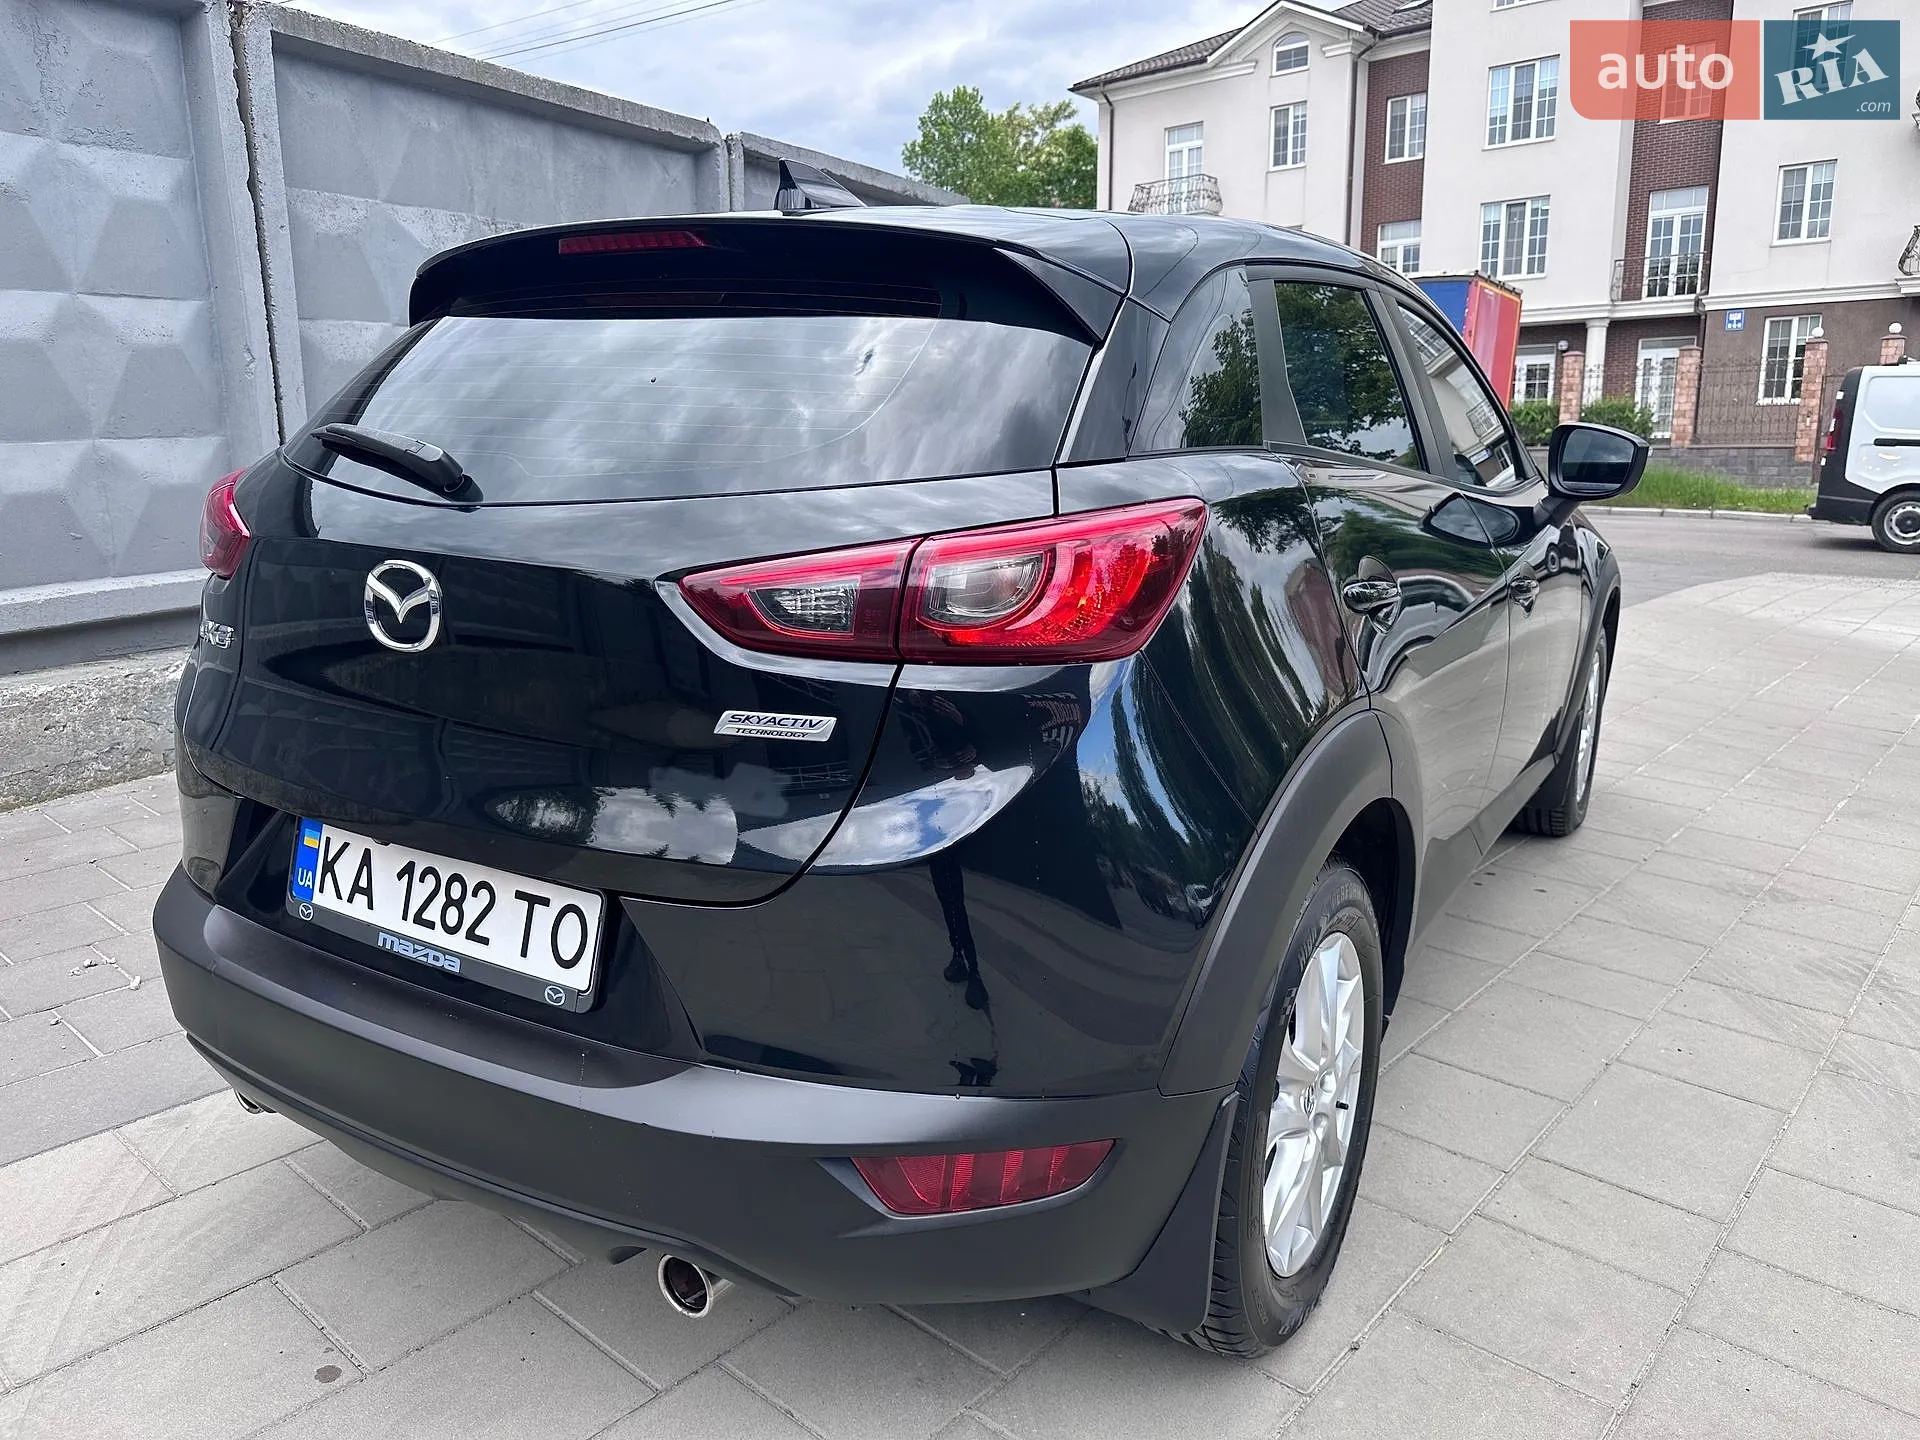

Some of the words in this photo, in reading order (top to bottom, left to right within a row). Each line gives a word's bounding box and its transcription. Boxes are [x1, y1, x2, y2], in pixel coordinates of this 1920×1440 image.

[727, 713, 824, 729] SKYACTIV
[735, 727, 809, 739] TECHNOLOGY
[297, 866, 313, 890] UA
[318, 836, 374, 911] KA
[396, 860, 497, 947] 1282
[514, 889, 589, 970] TO
